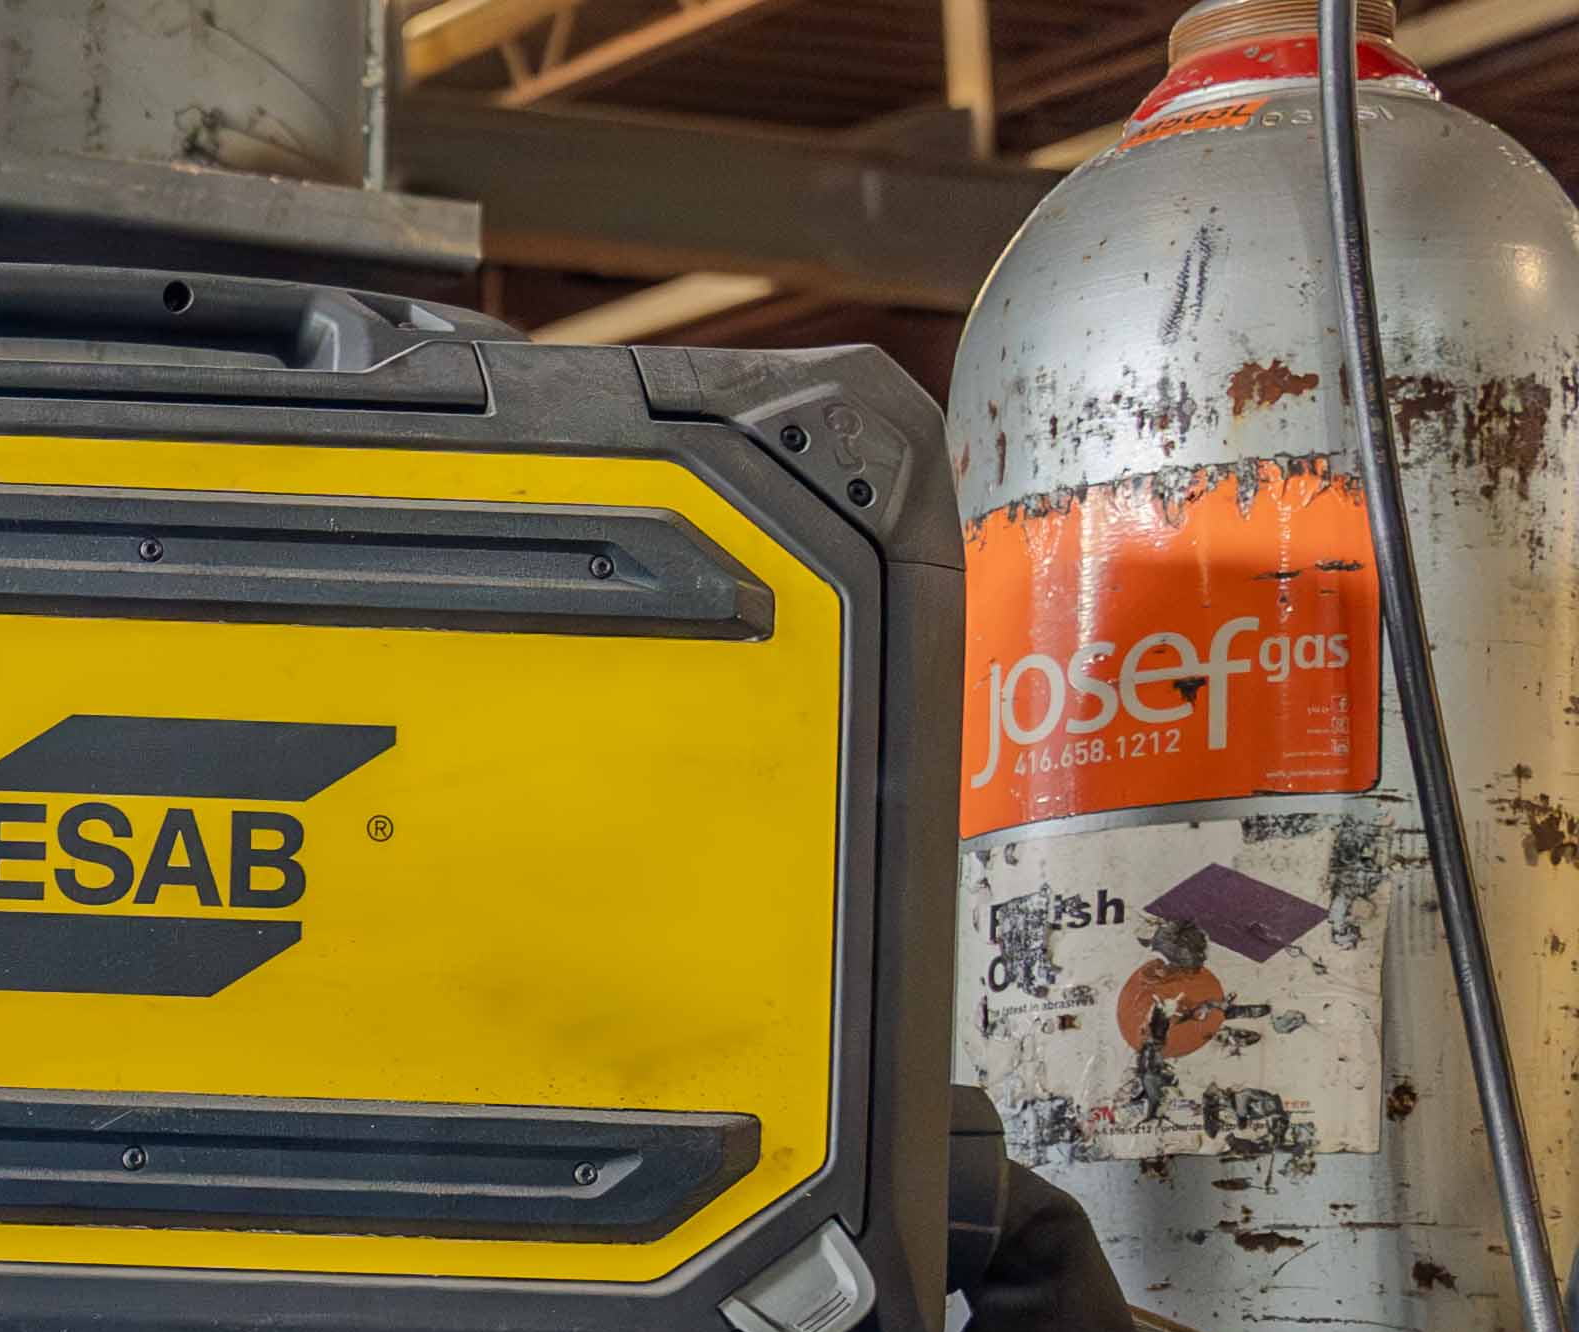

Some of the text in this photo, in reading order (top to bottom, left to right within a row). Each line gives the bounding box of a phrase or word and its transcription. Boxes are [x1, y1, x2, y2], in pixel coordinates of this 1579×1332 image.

[970, 615, 1351, 788] josef gas
[1013, 728, 1181, 777] 416.658.1212
